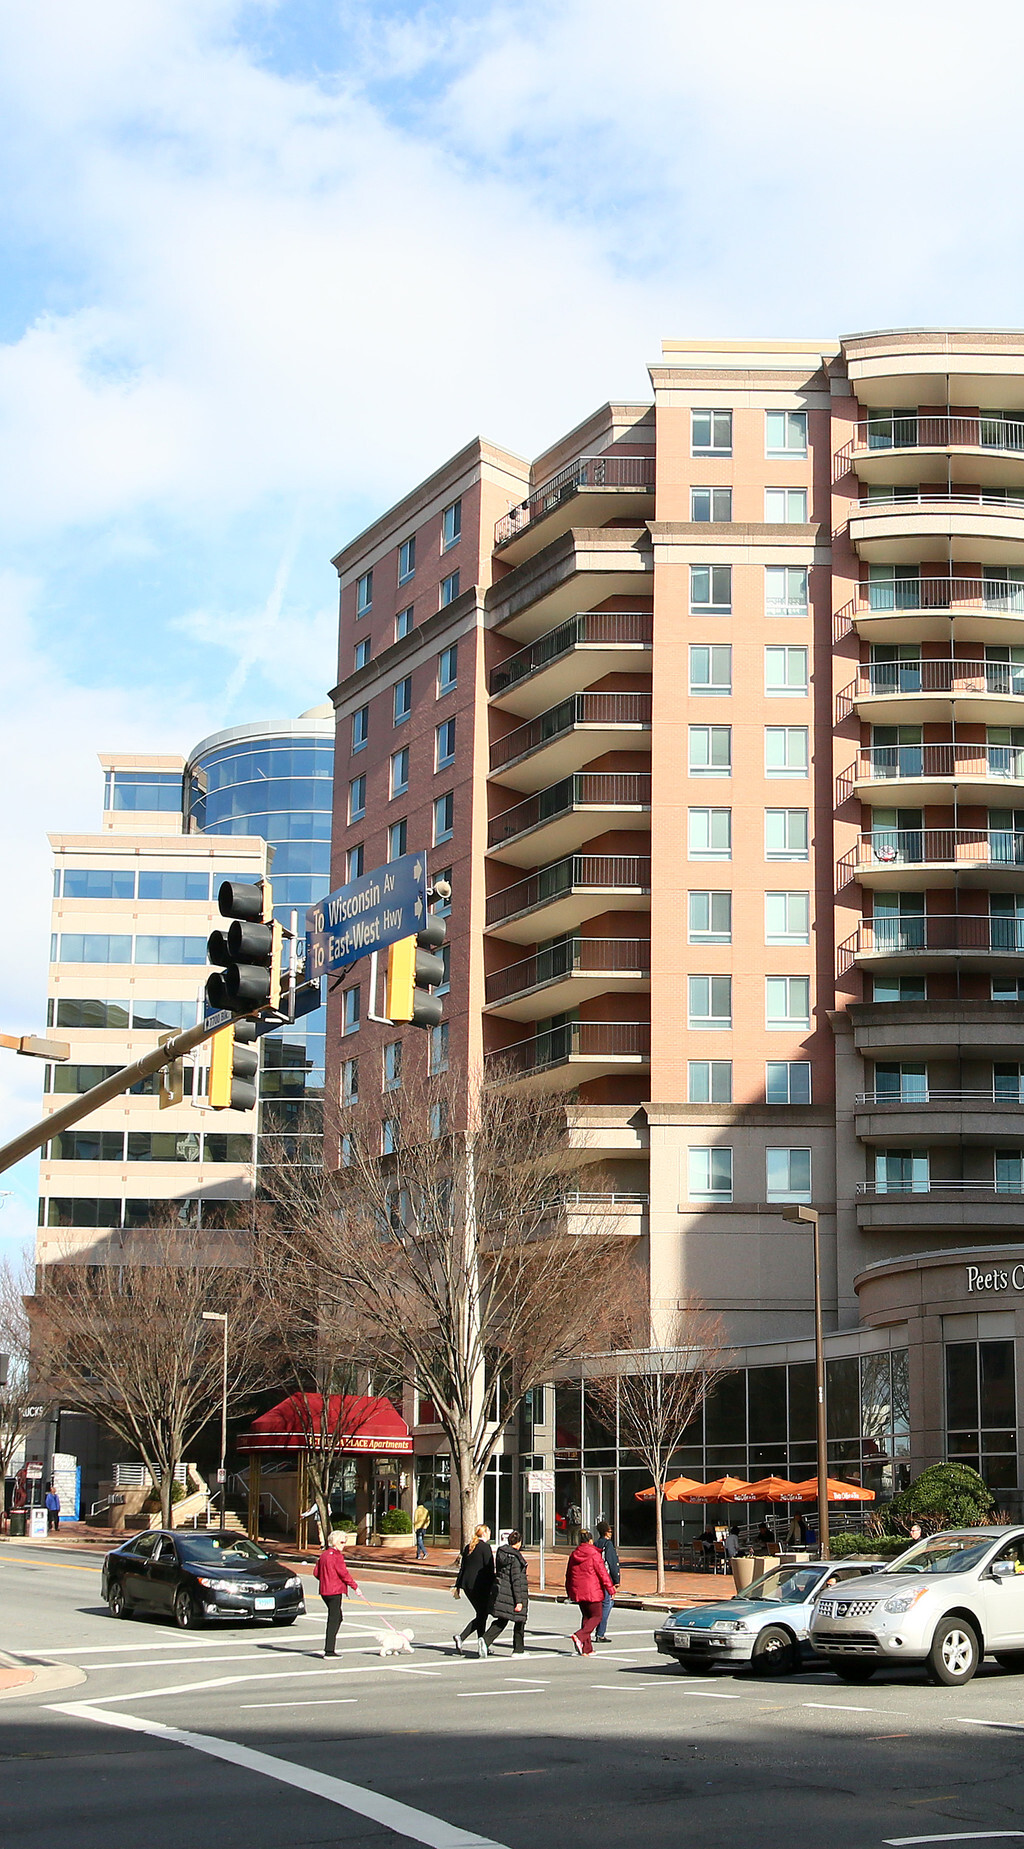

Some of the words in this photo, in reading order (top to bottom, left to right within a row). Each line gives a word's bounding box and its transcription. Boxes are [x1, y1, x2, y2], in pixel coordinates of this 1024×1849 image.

[313, 909, 324, 934] To
[328, 880, 380, 927] Wisconsin
[384, 873, 395, 894] Av
[313, 943, 324, 969] To
[328, 916, 380, 962] East-West
[383, 907, 403, 930] Hwy
[965, 1266, 1008, 1292] Peet's
[345, 1438, 369, 1448] PLACE
[369, 1439, 409, 1450] Apartments
